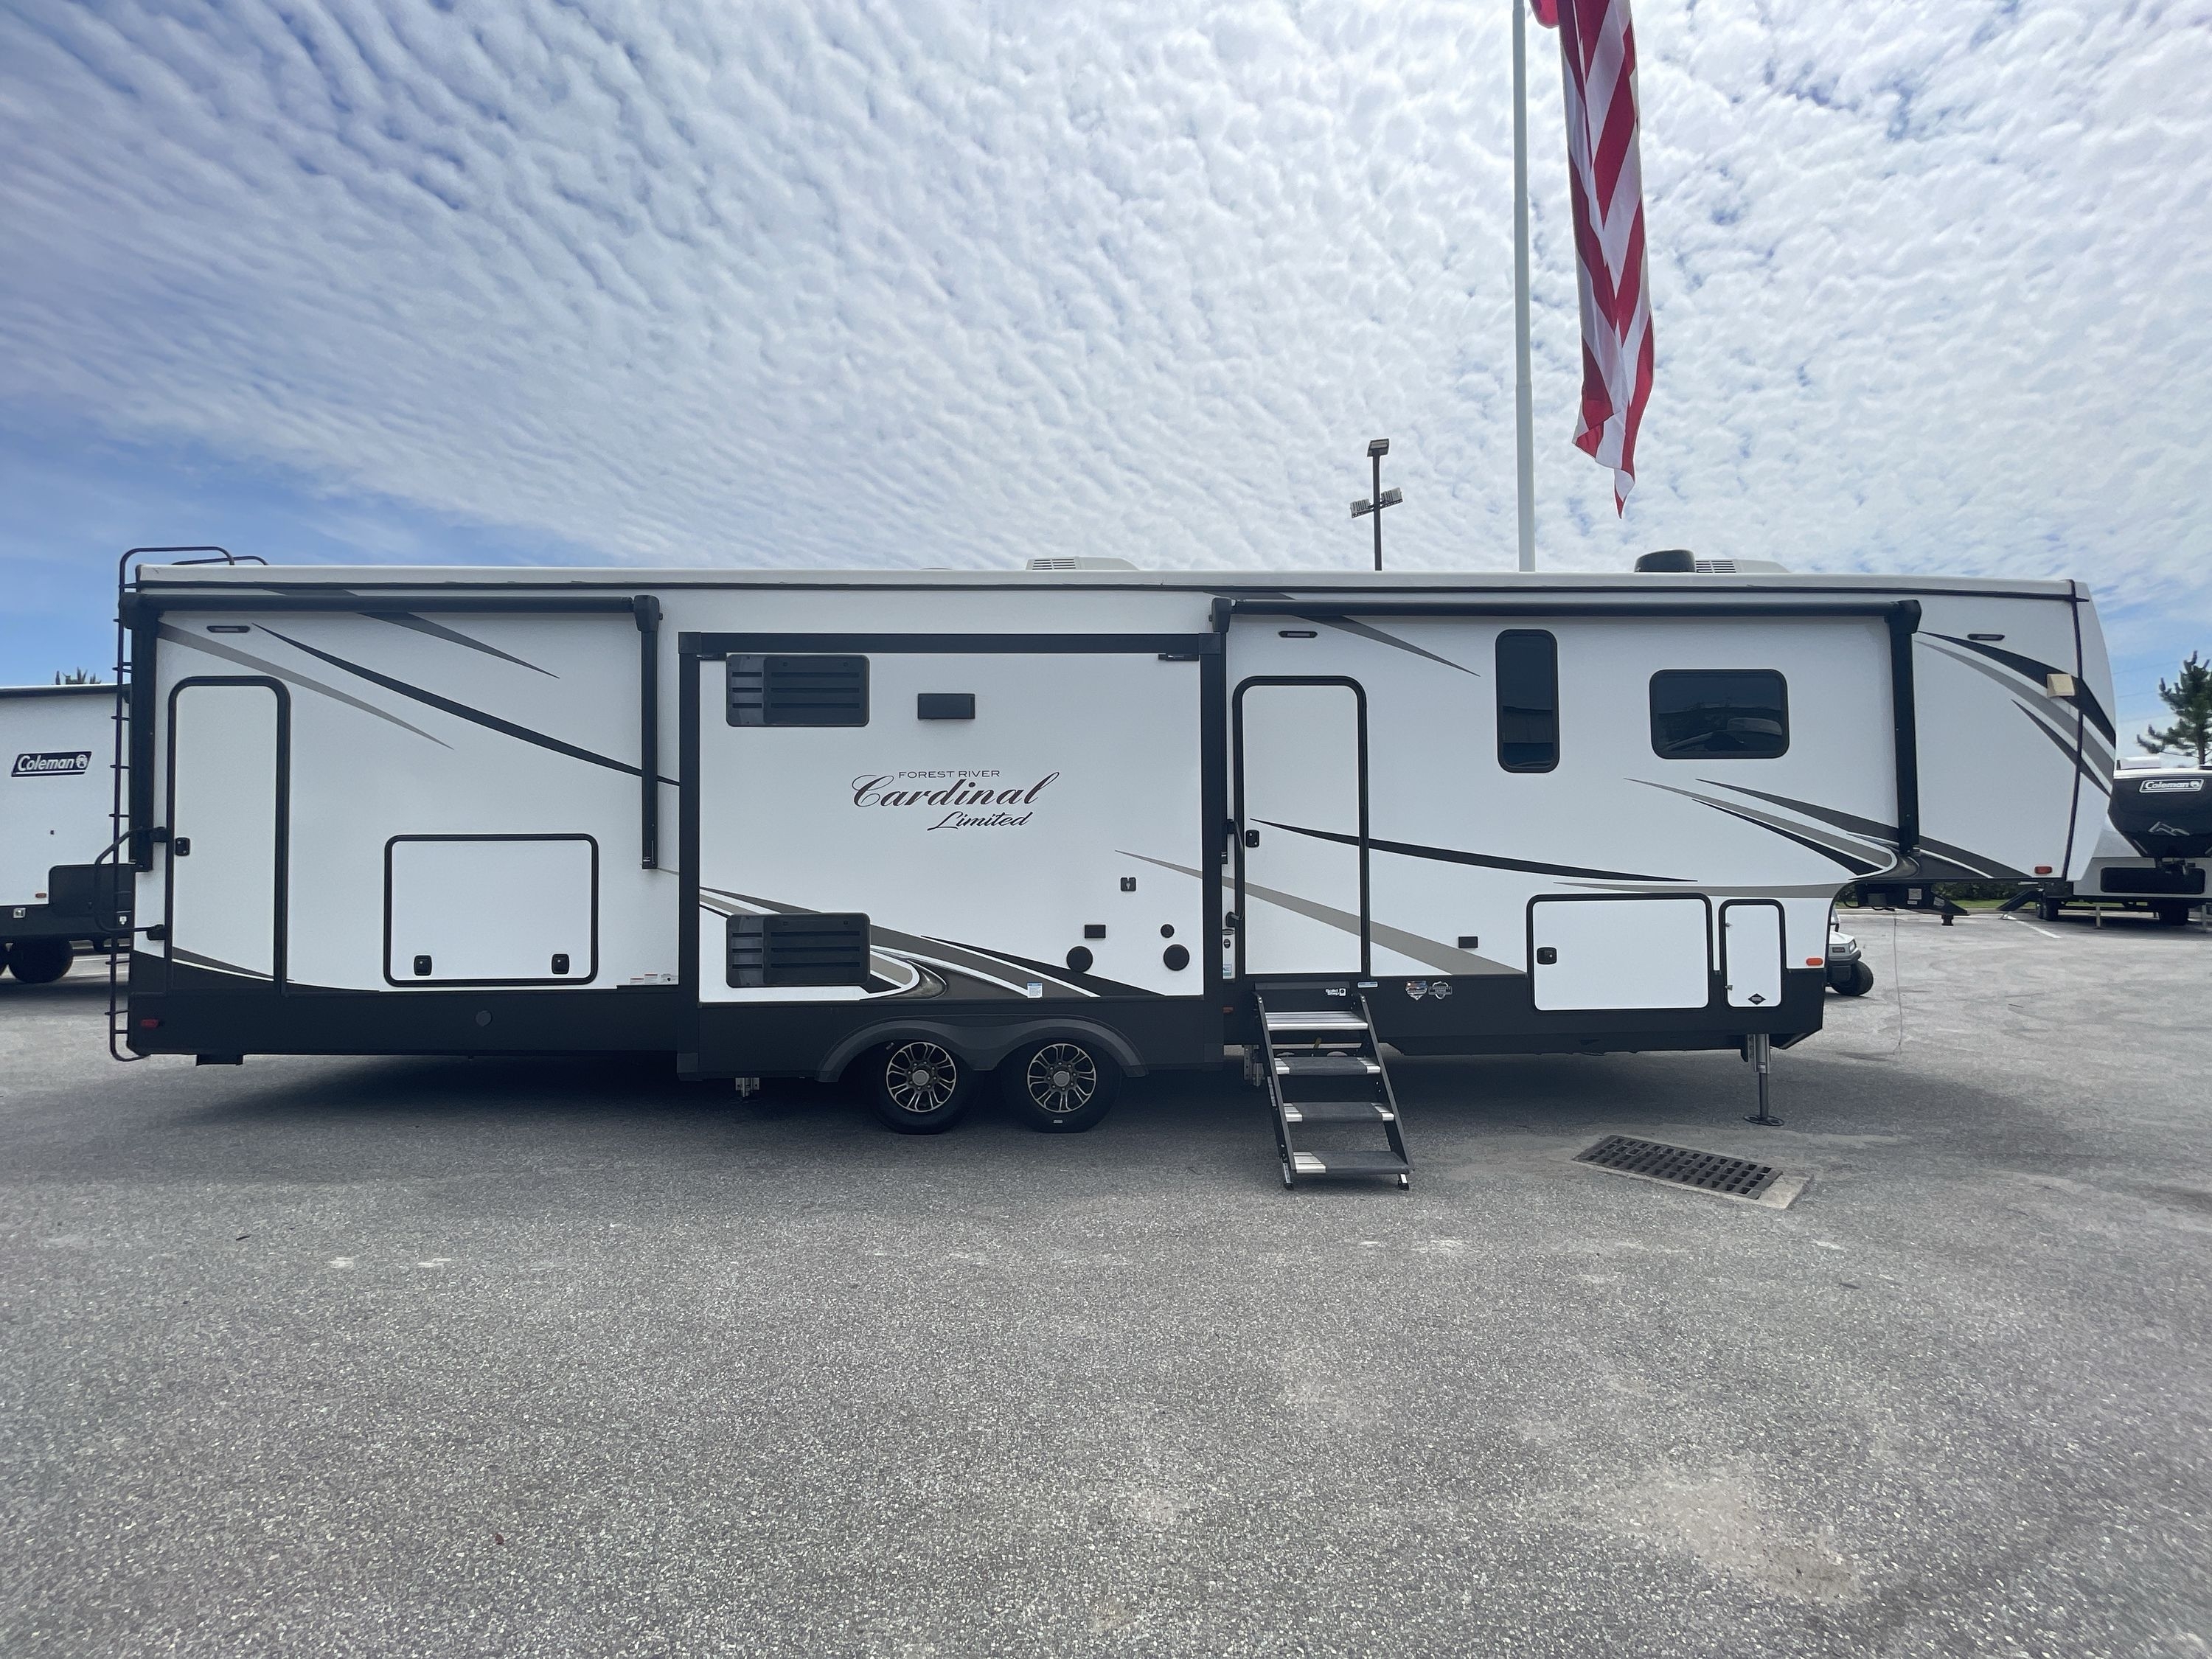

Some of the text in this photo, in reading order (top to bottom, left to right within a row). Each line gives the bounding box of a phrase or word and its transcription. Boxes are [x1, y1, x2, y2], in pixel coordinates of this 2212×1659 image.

[18, 755, 74, 771] Coleman
[899, 771, 955, 779] FOREST
[852, 771, 1060, 807] Cardinal
[927, 811, 1033, 831] Limited
